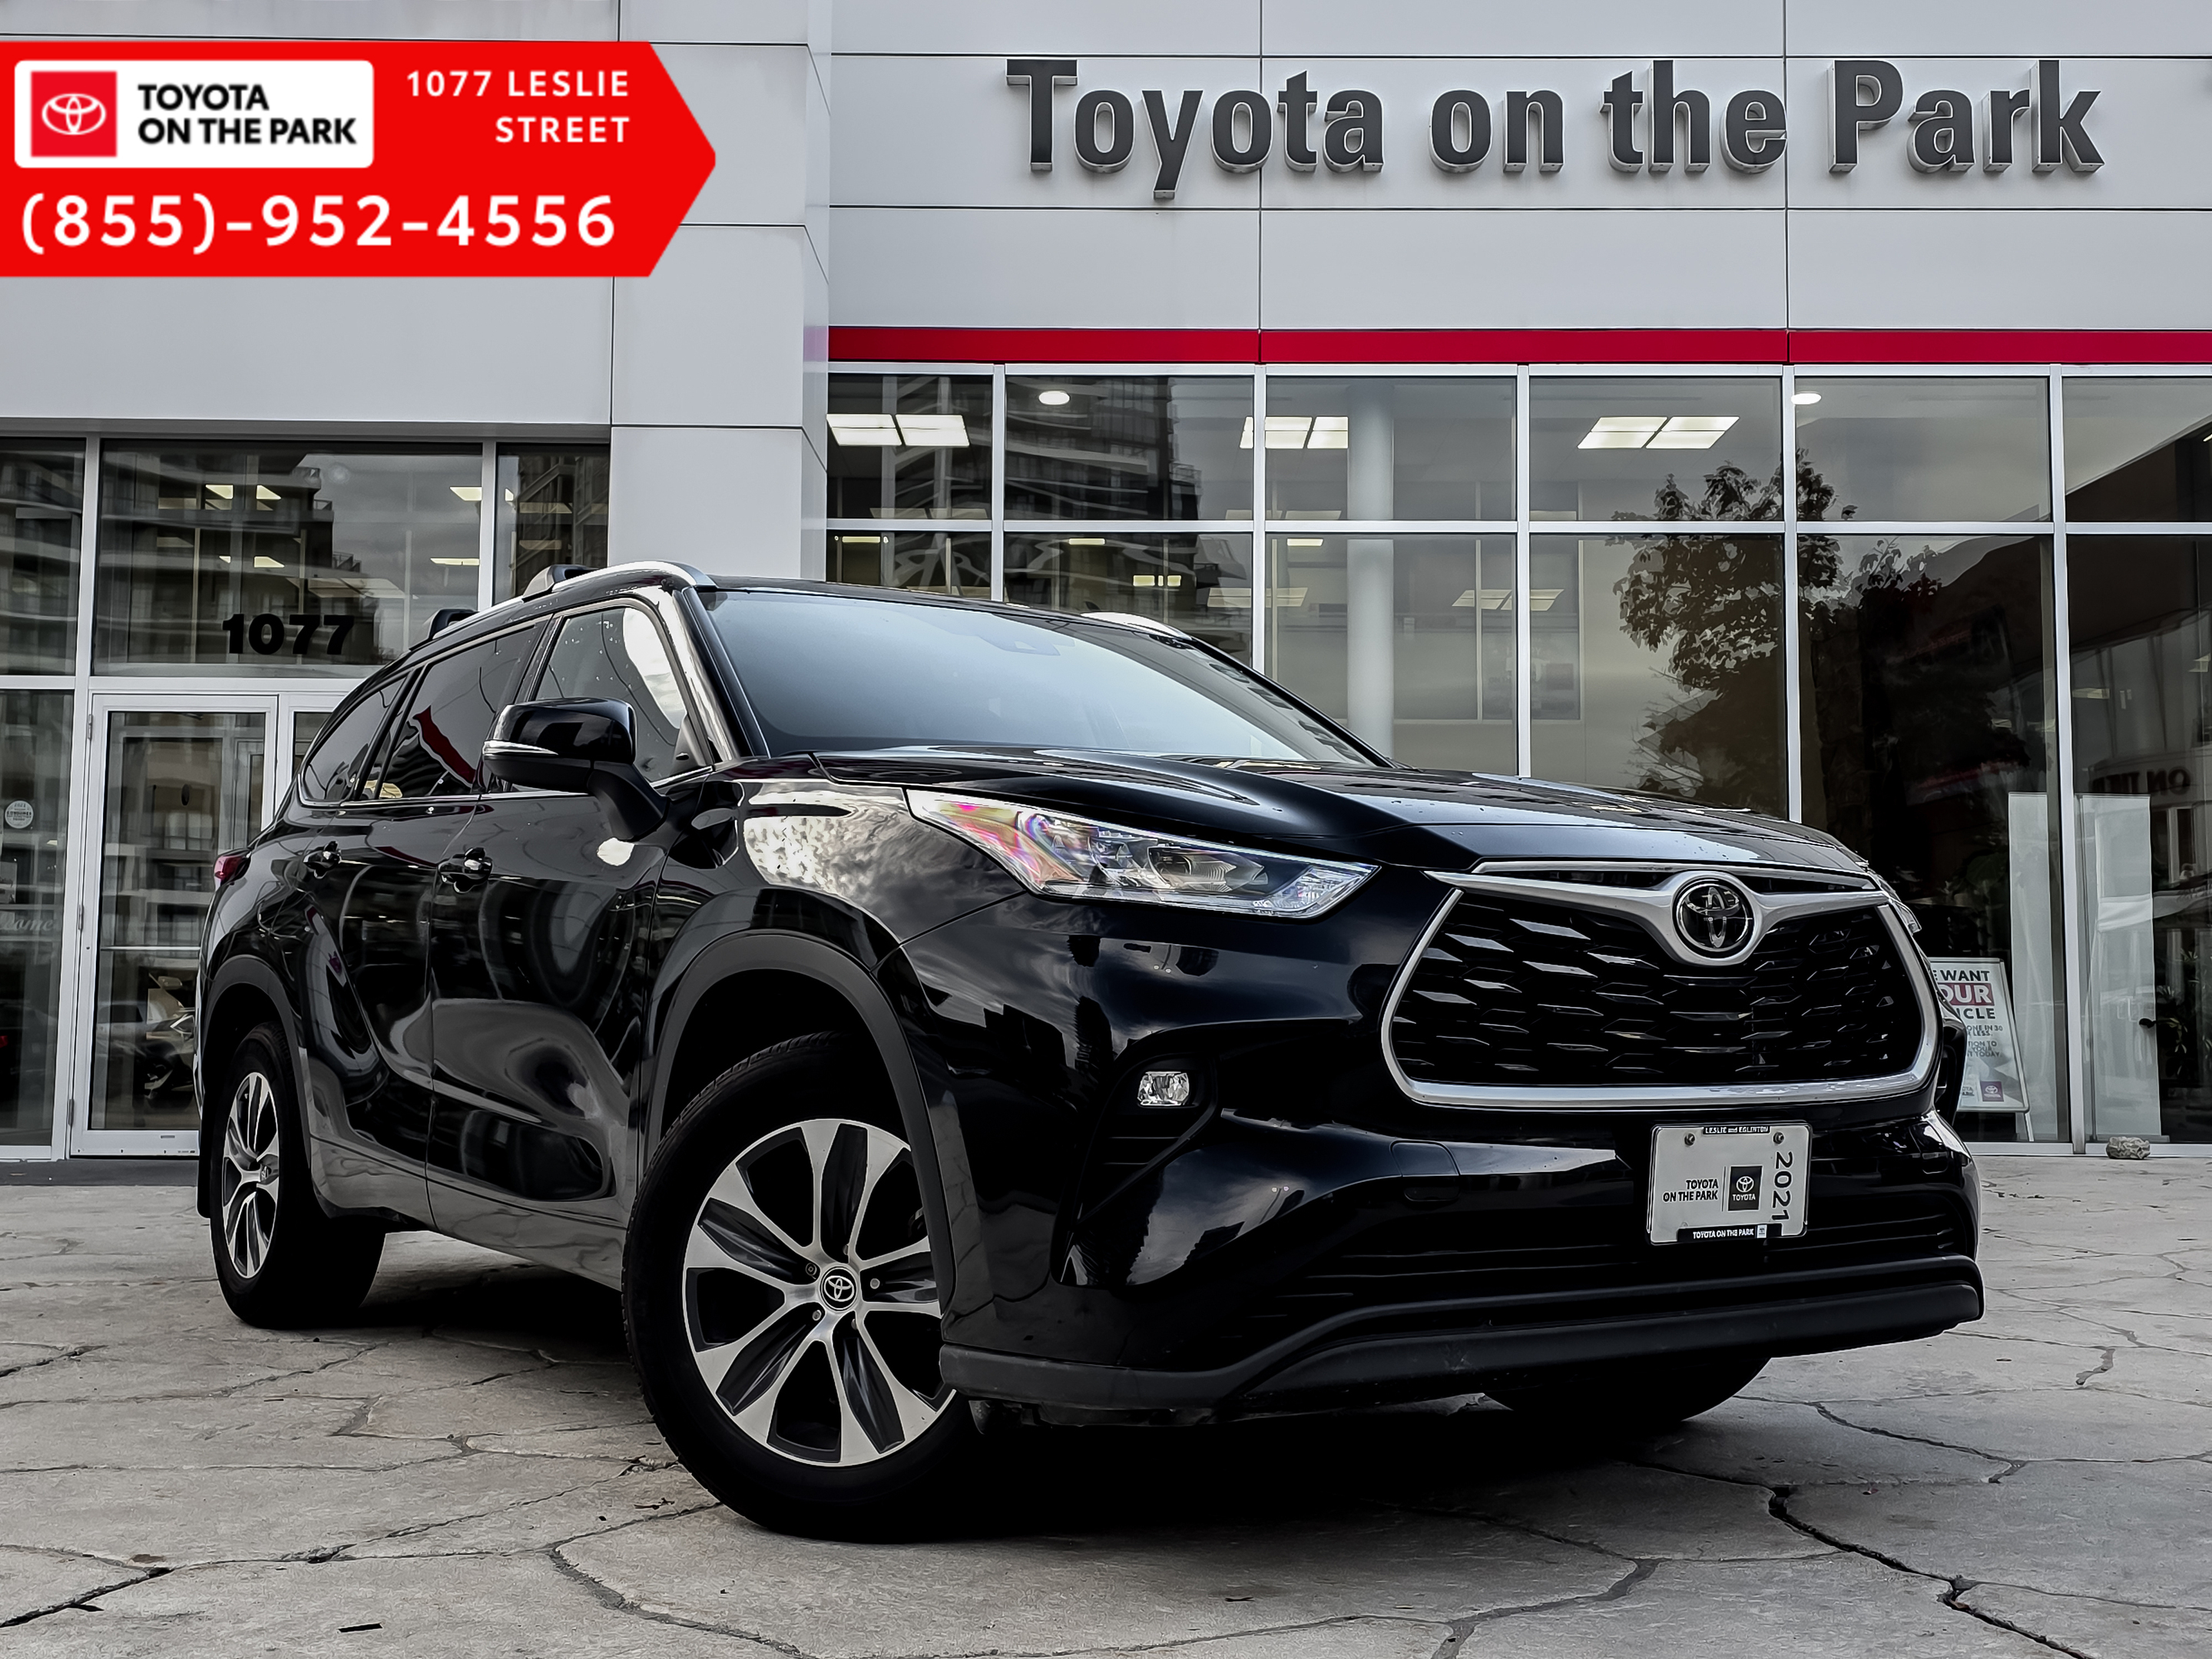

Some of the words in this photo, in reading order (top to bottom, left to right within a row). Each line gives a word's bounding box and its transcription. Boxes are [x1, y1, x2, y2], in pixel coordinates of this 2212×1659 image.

[1006, 59, 1384, 199] Toyota
[1429, 88, 1565, 174] on
[1601, 59, 1788, 174] the
[1828, 59, 2105, 174] Park
[221, 613, 355, 655] 1077
[1940, 970, 1990, 982] WANT
[1937, 984, 1992, 1003] OUR
[1686, 1179, 1719, 1190] TOYOTA
[1771, 1151, 1793, 1221] 2021
[1663, 1192, 1677, 1202] ON
[1678, 1190, 1694, 1201] THE
[1695, 1190, 1718, 1200] PARK
[1693, 1230, 1716, 1239] TOYOTA
